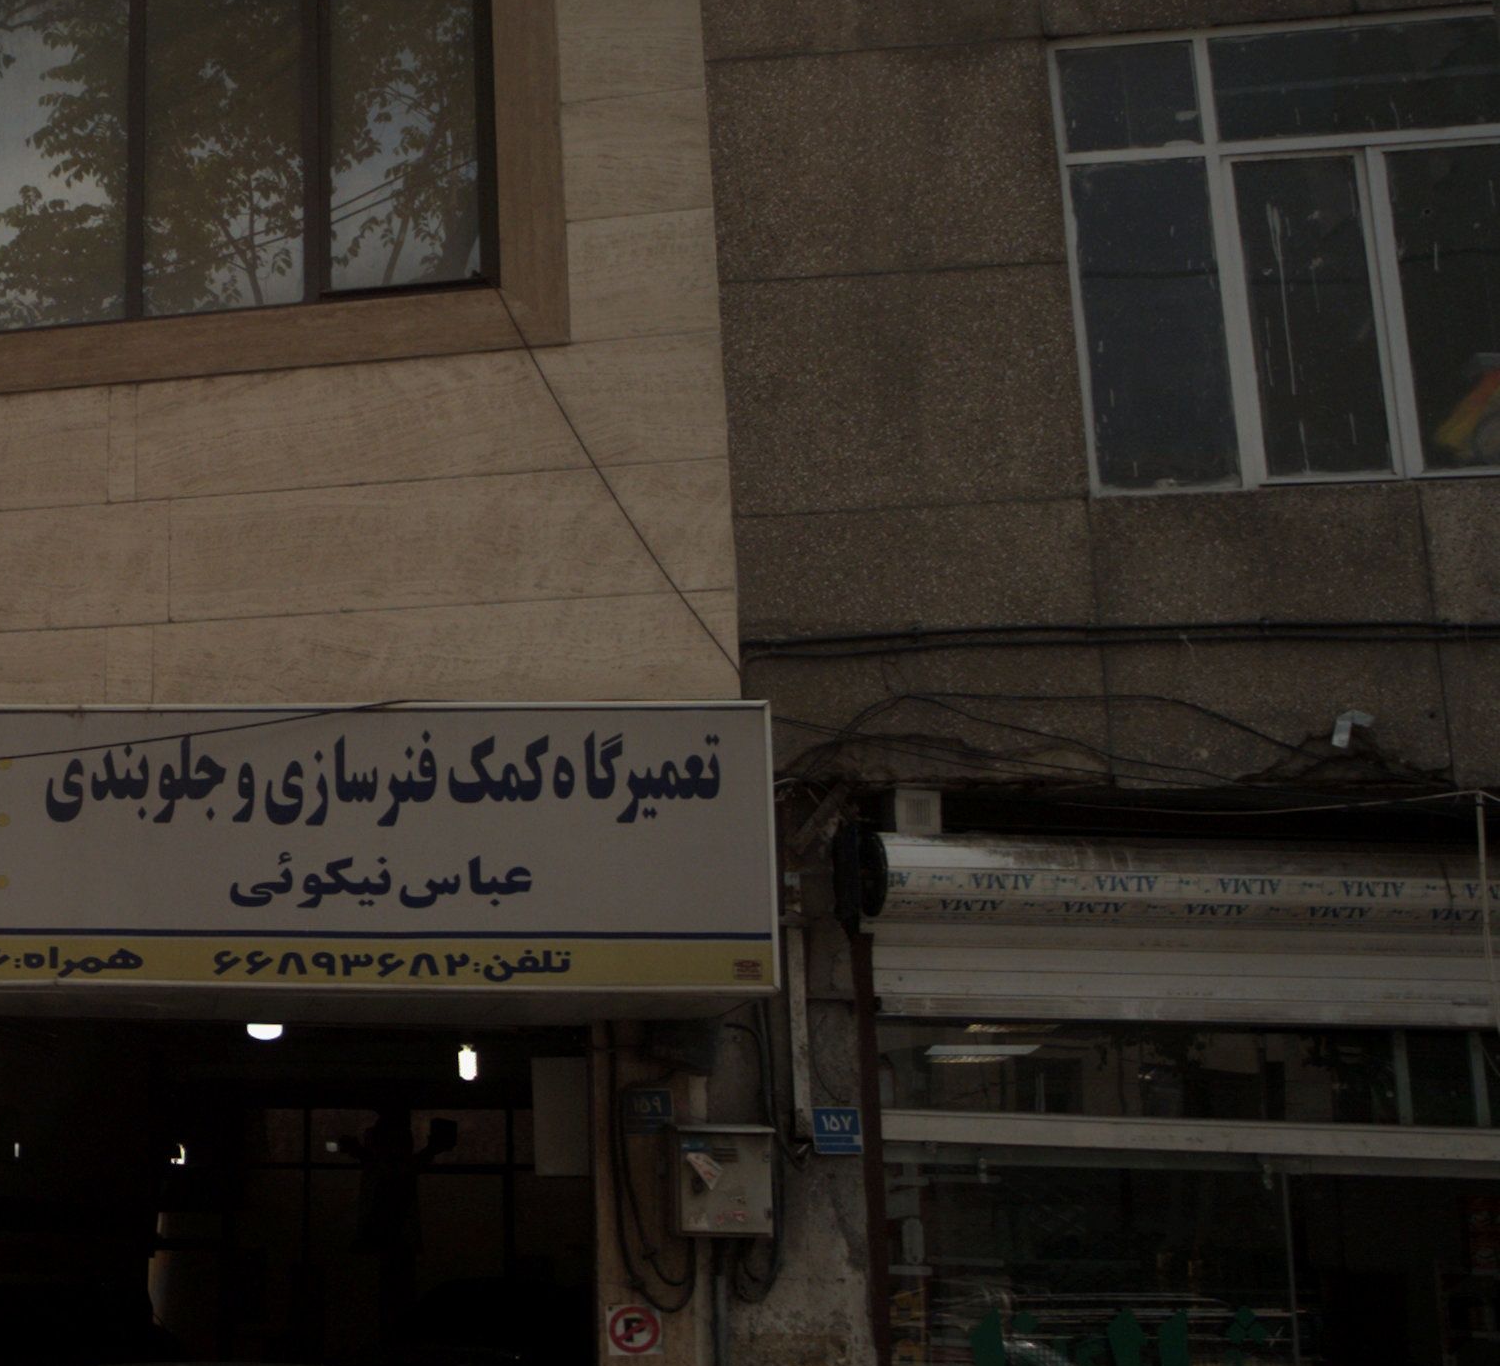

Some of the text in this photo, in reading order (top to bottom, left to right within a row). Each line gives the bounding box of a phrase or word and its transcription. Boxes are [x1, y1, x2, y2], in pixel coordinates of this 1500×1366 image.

[448, 735, 550, 804] کمک
[232, 772, 256, 824] و
[229, 851, 534, 909] عباس نیکوئی
[821, 1114, 852, 1132] ۱۵۷
